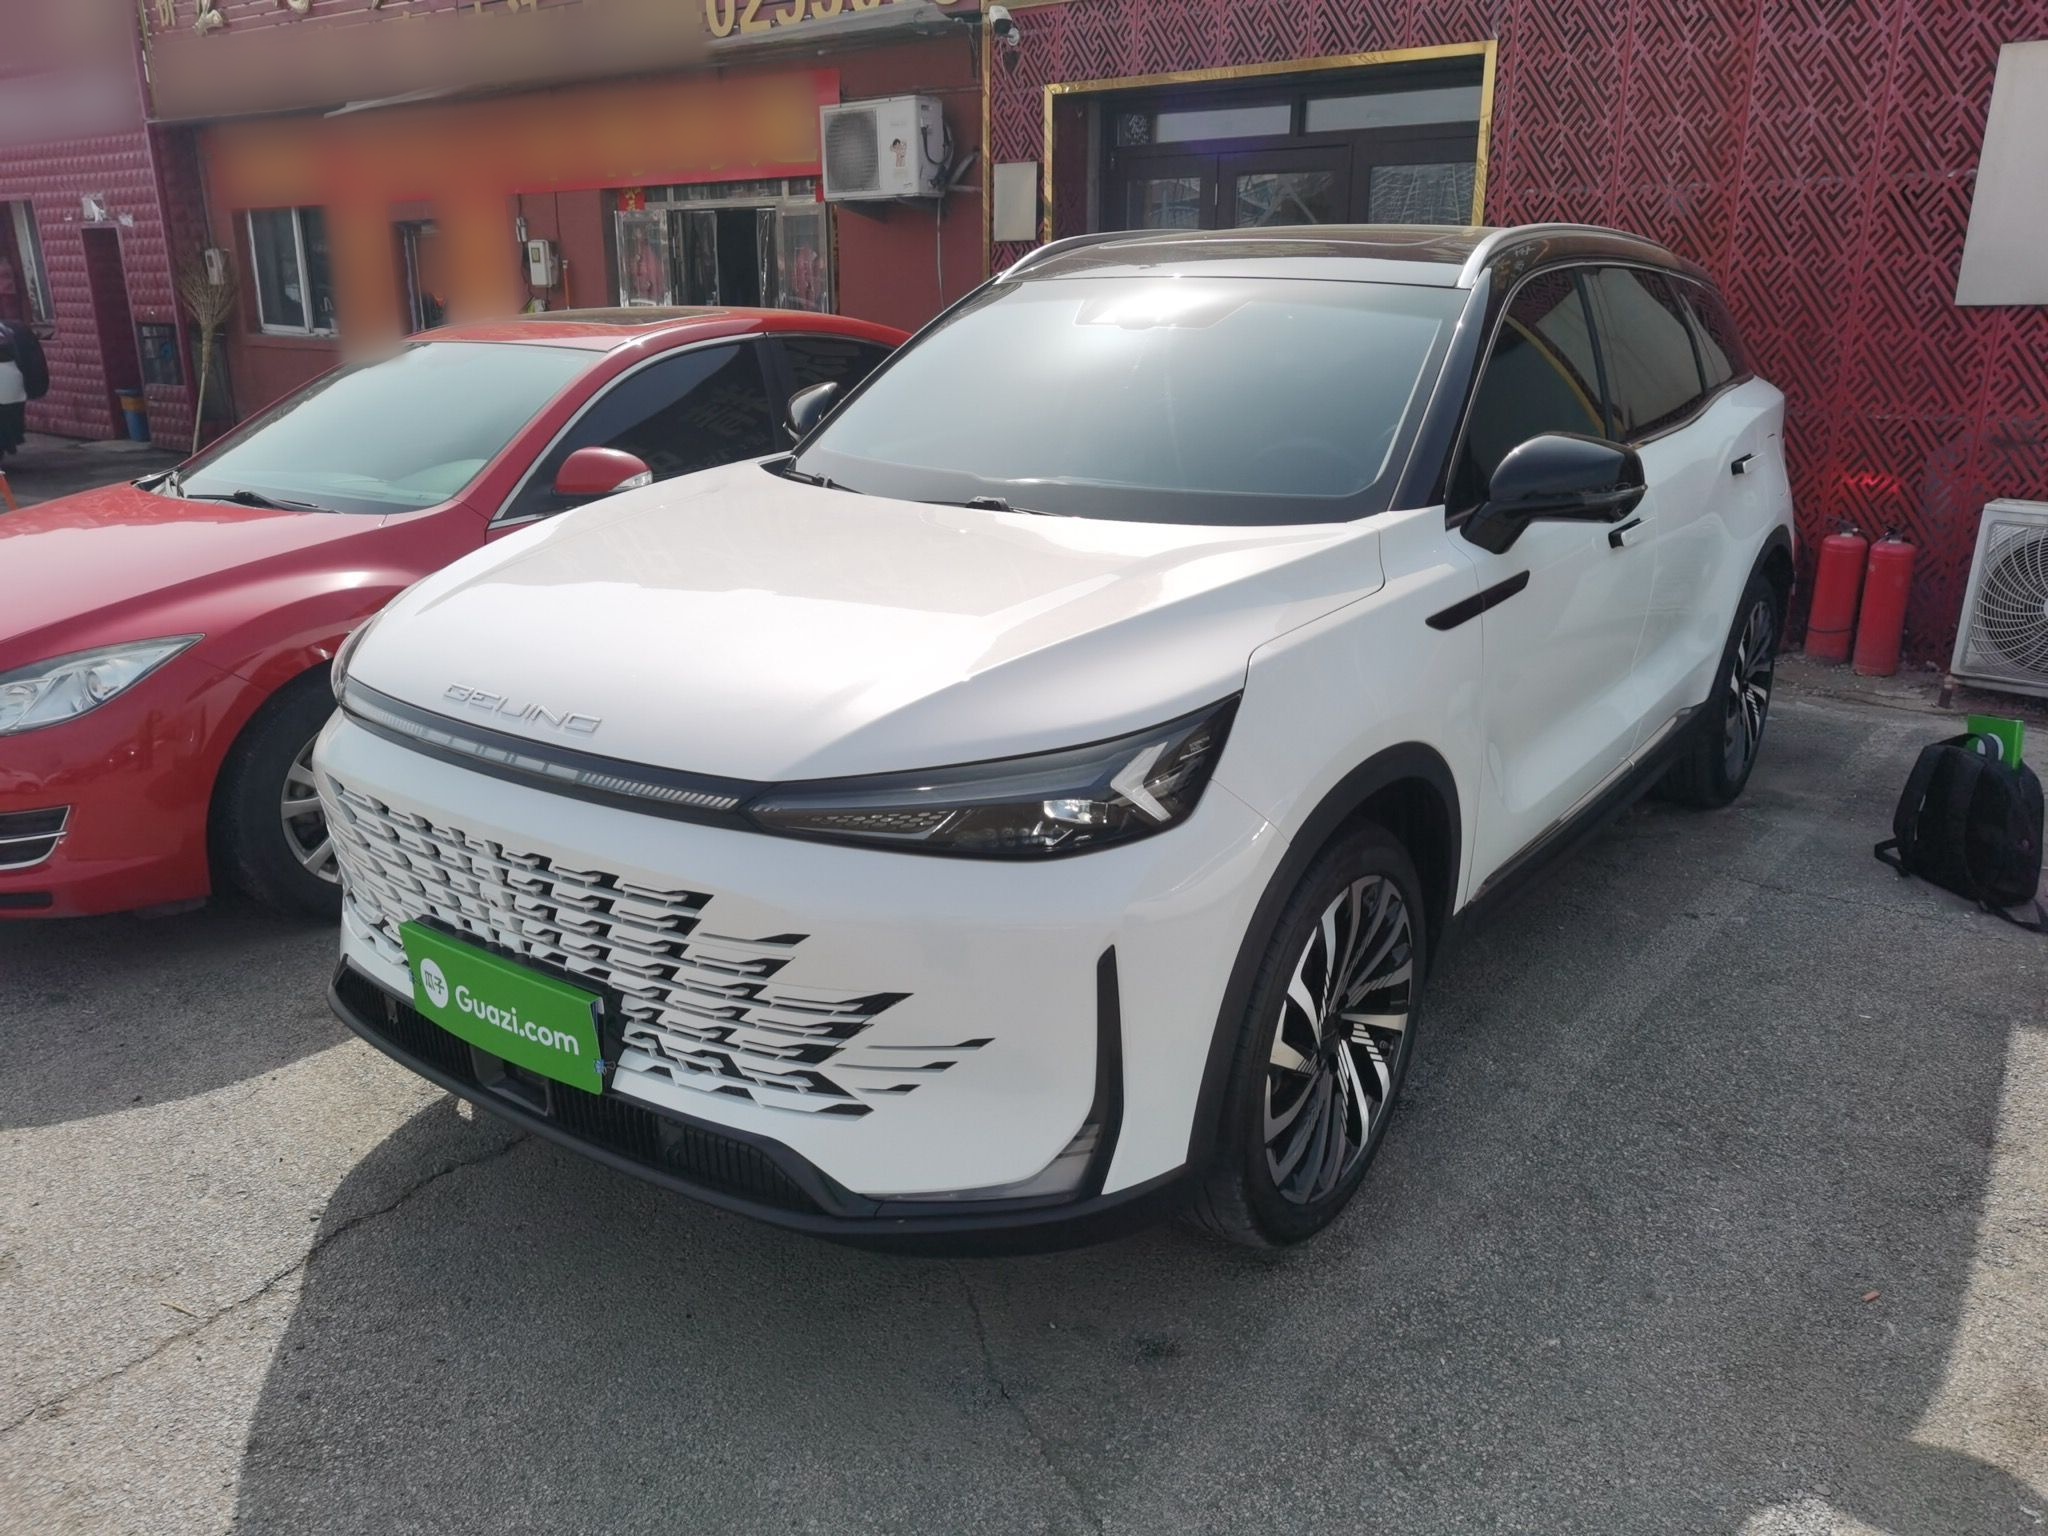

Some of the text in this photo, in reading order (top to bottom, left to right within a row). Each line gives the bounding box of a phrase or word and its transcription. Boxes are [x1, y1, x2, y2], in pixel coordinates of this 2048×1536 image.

[443, 682, 602, 733] BEIJING
[424, 969, 445, 995] 瓜子
[455, 985, 580, 1056] Guazi.com
